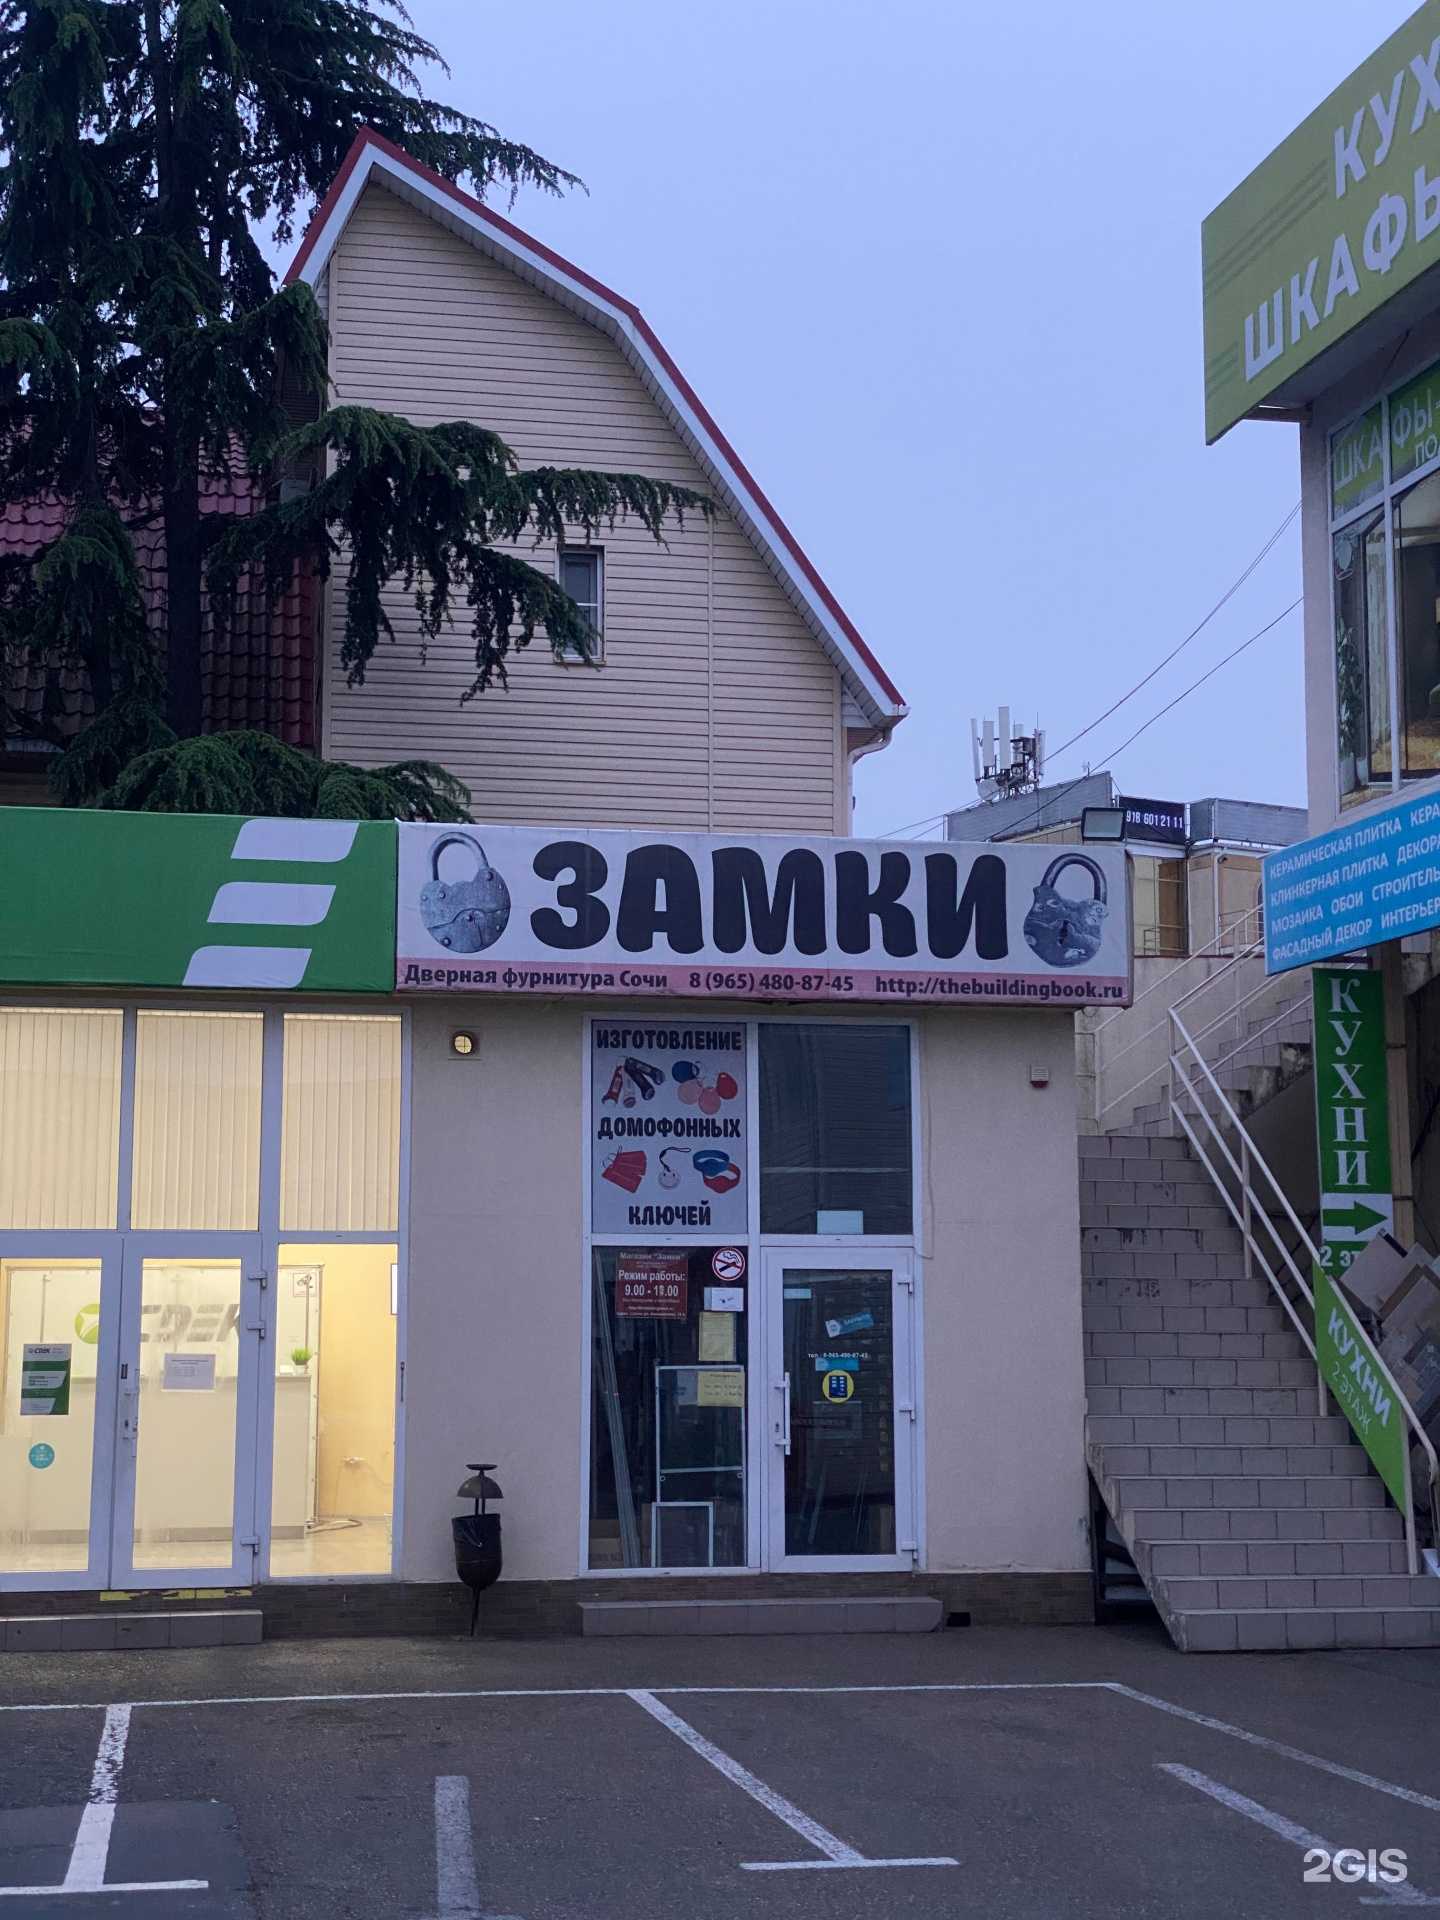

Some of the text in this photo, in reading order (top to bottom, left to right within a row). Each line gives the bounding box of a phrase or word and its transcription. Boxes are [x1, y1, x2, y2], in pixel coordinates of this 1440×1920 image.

[1126, 810, 1141, 824] 918
[1143, 813, 1159, 826] 601
[1270, 836, 1351, 879] КЕРАМИЧЕСКАЯ
[1354, 817, 1402, 848] ПЛИТКА
[1270, 870, 1340, 907] КЛИНКЕРНАЯ
[1342, 853, 1389, 882] ПЛИТКА
[530, 840, 1009, 962] ЗАМКИ
[1272, 904, 1324, 936] МОЗАИКА
[1331, 891, 1364, 915] ОБОИ
[1272, 925, 1333, 961] ФАСАДНЫЙ
[1335, 918, 1373, 945] ДЕКОР
[404, 964, 1123, 1000] Дверная фурнитура Сочи 8 (965) 480-87-45 http://thebuildingbook.ru
[596, 1028, 742, 1051] ИЗГОТОВЛЕНИЕ
[1328, 977, 1372, 1186] КУХНИ
[597, 1116, 741, 1140] ДОМОФОННЫХ
[628, 1200, 712, 1226] КЛЮЧЕЙ
[1320, 1245, 1334, 1267] 2
[618, 1270, 686, 1283] Режим работы:
[624, 1284, 645, 1296] 9.00
[1328, 1306, 1392, 1427] КУХНИ
